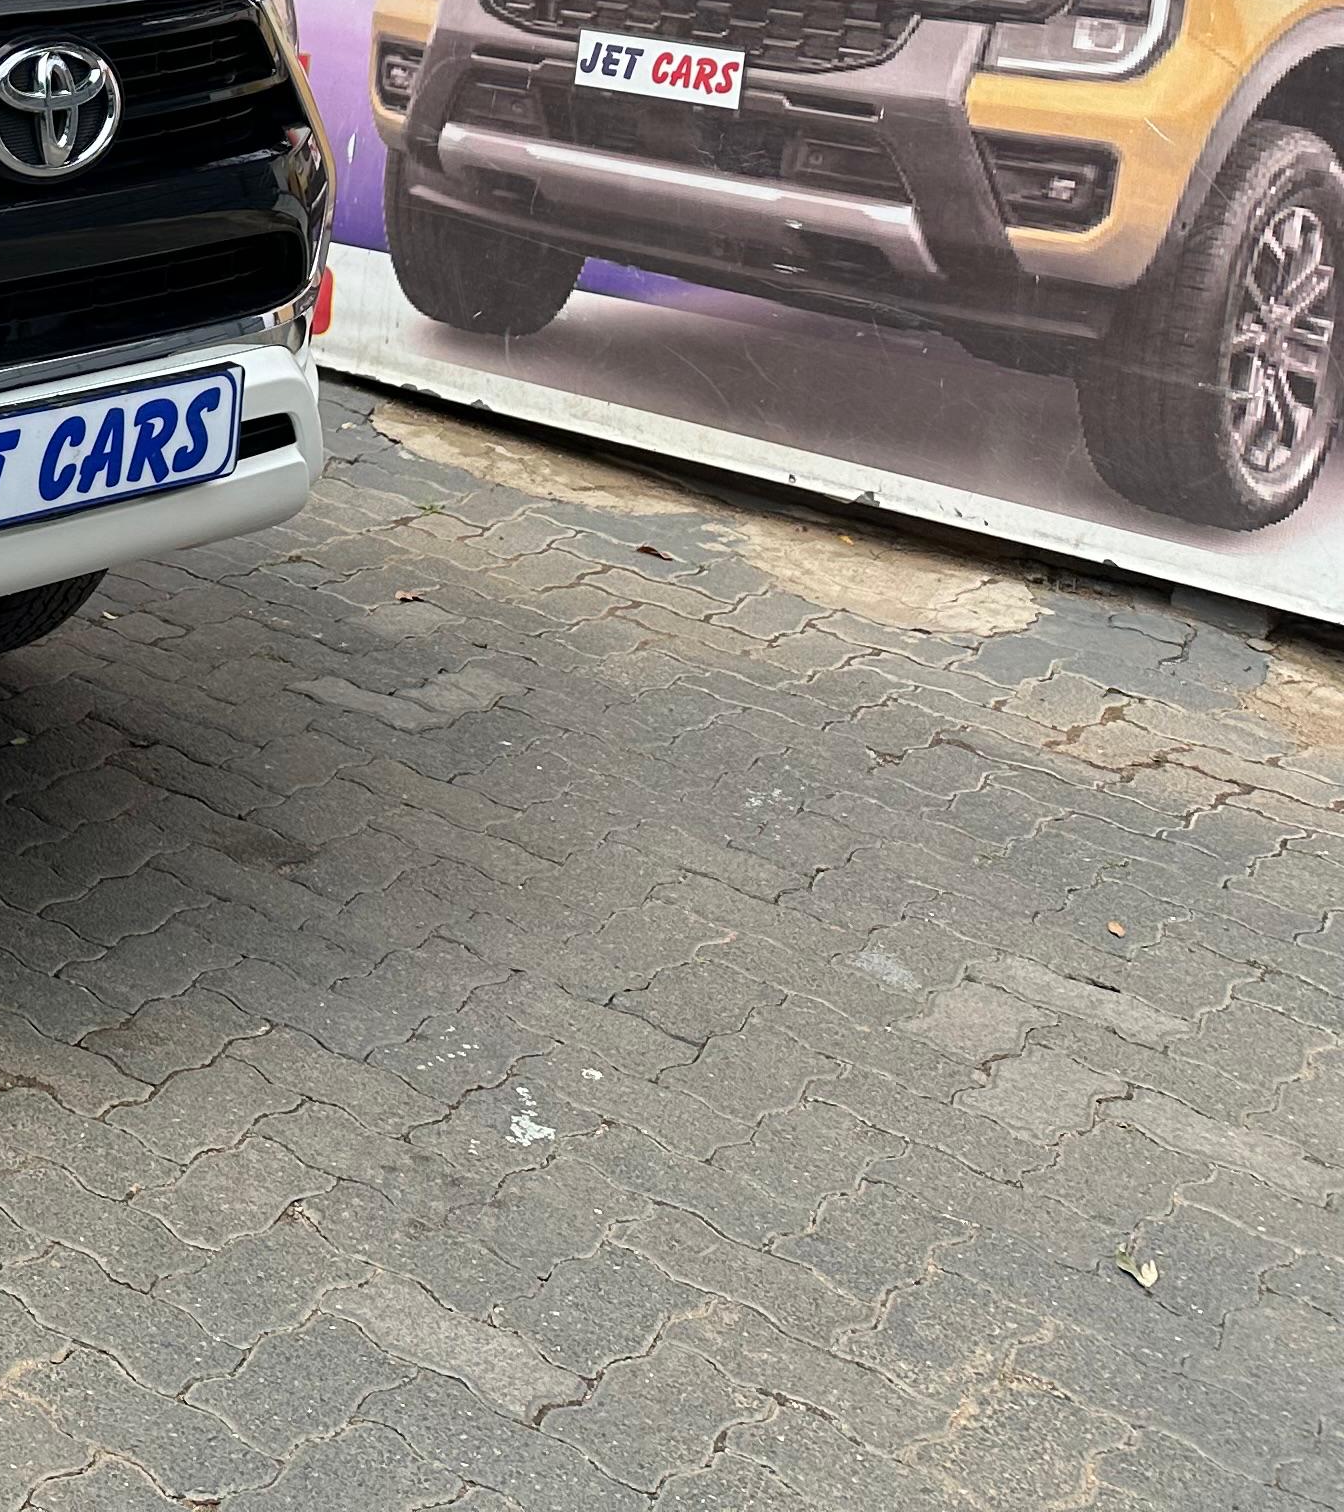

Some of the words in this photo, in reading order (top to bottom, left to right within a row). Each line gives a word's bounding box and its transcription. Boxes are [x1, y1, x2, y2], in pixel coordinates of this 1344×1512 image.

[579, 41, 644, 80] JET
[651, 51, 740, 95] CARS
[38, 387, 221, 502] CARS
